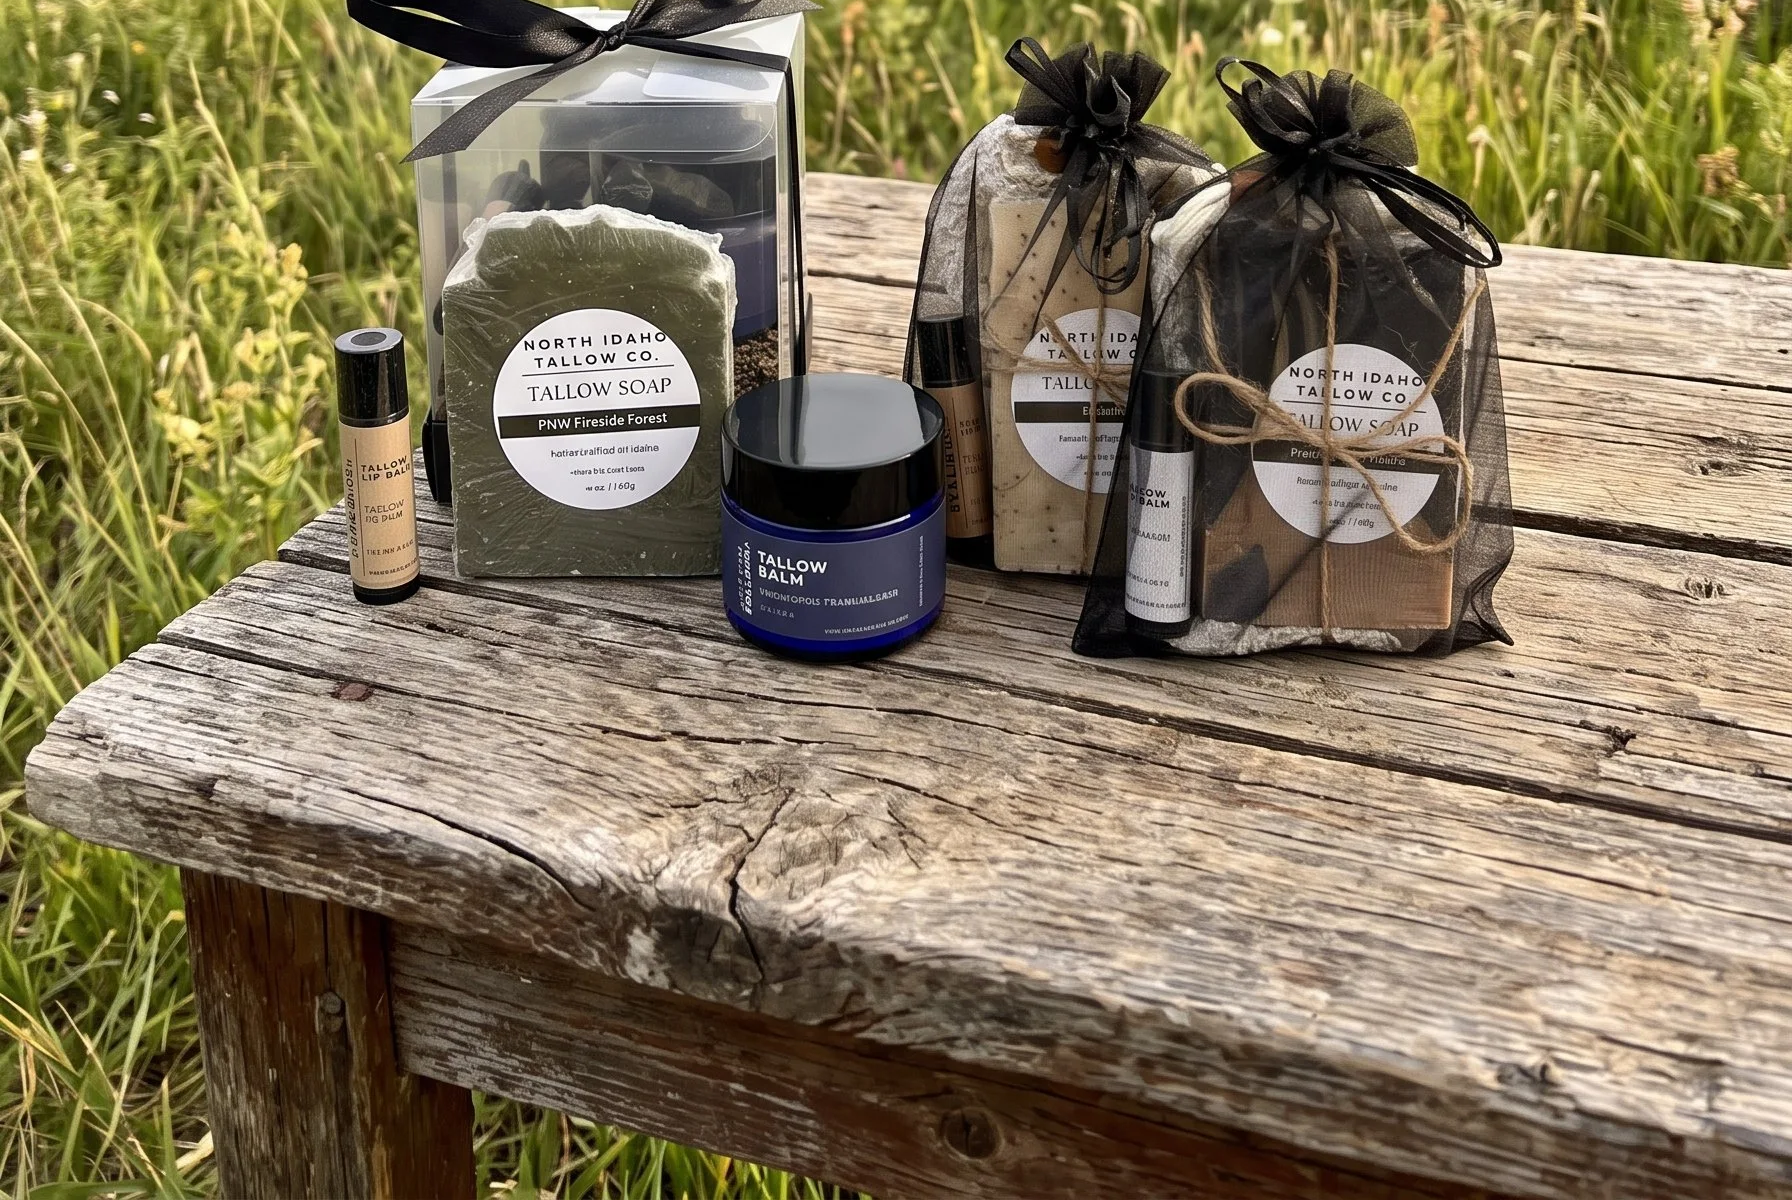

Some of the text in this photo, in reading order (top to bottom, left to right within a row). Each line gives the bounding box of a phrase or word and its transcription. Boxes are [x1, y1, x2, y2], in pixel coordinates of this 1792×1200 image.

[524, 332, 667, 351] NORTH IDAHO
[534, 350, 659, 369] TALLOW CO.
[1290, 366, 1423, 387] NORTH IDAHO
[527, 377, 672, 402] TALLOW SOAP
[538, 412, 668, 431] PNW Fireside Forest
[361, 455, 408, 473] TALLOW
[361, 472, 381, 482] LIP
[1139, 496, 1171, 509] BALM
[757, 550, 828, 574] TALLOW
[758, 564, 804, 587] BALM
